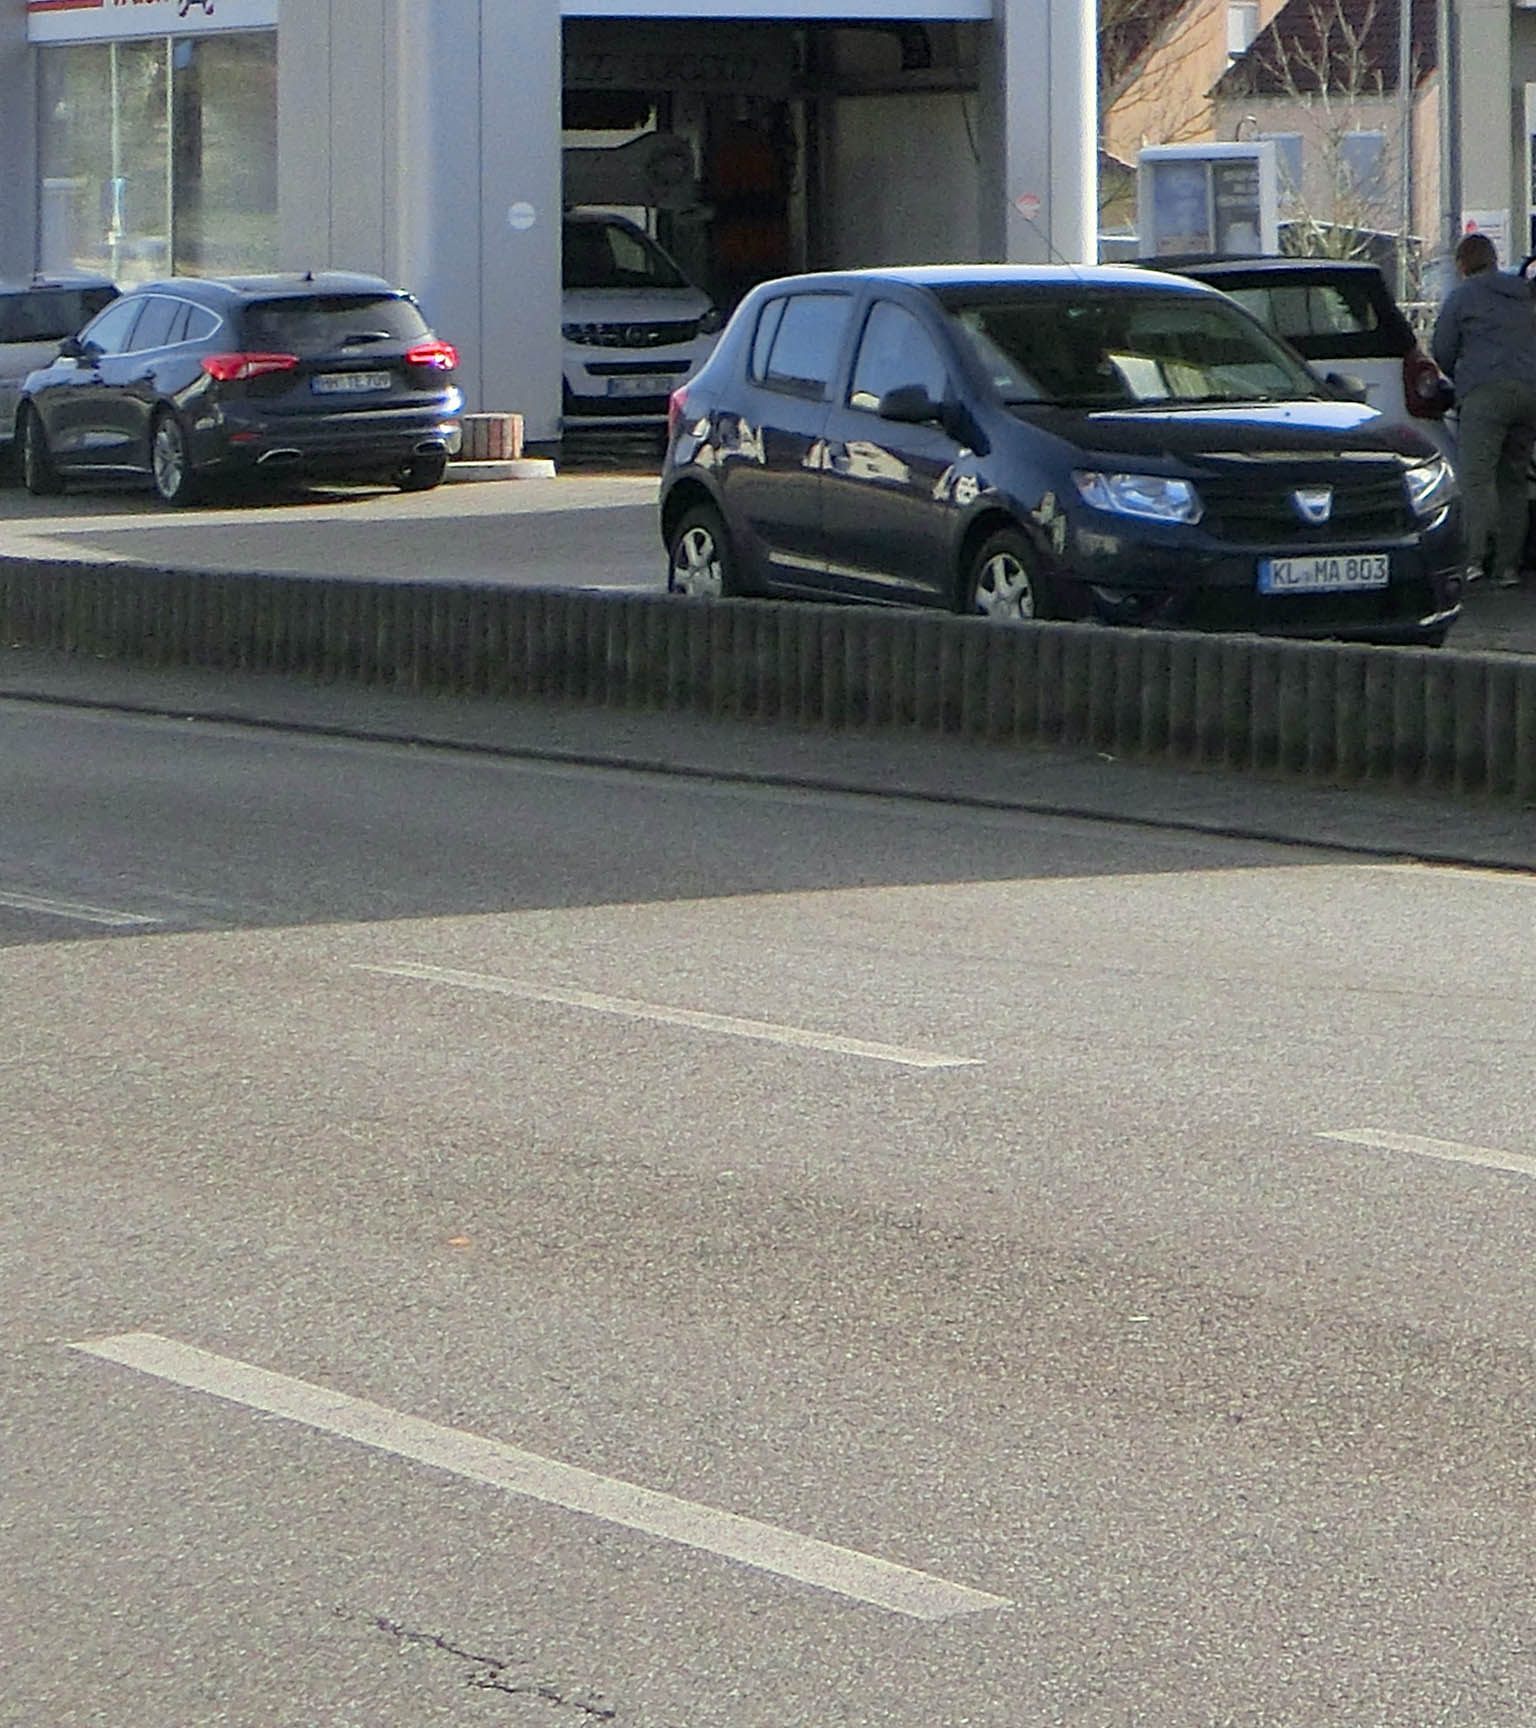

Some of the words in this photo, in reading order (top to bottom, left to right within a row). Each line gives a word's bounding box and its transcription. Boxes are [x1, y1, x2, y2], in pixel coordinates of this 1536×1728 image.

[1273, 563, 1299, 585] KL
[1314, 561, 1340, 583] MA
[1346, 558, 1387, 580] 803
